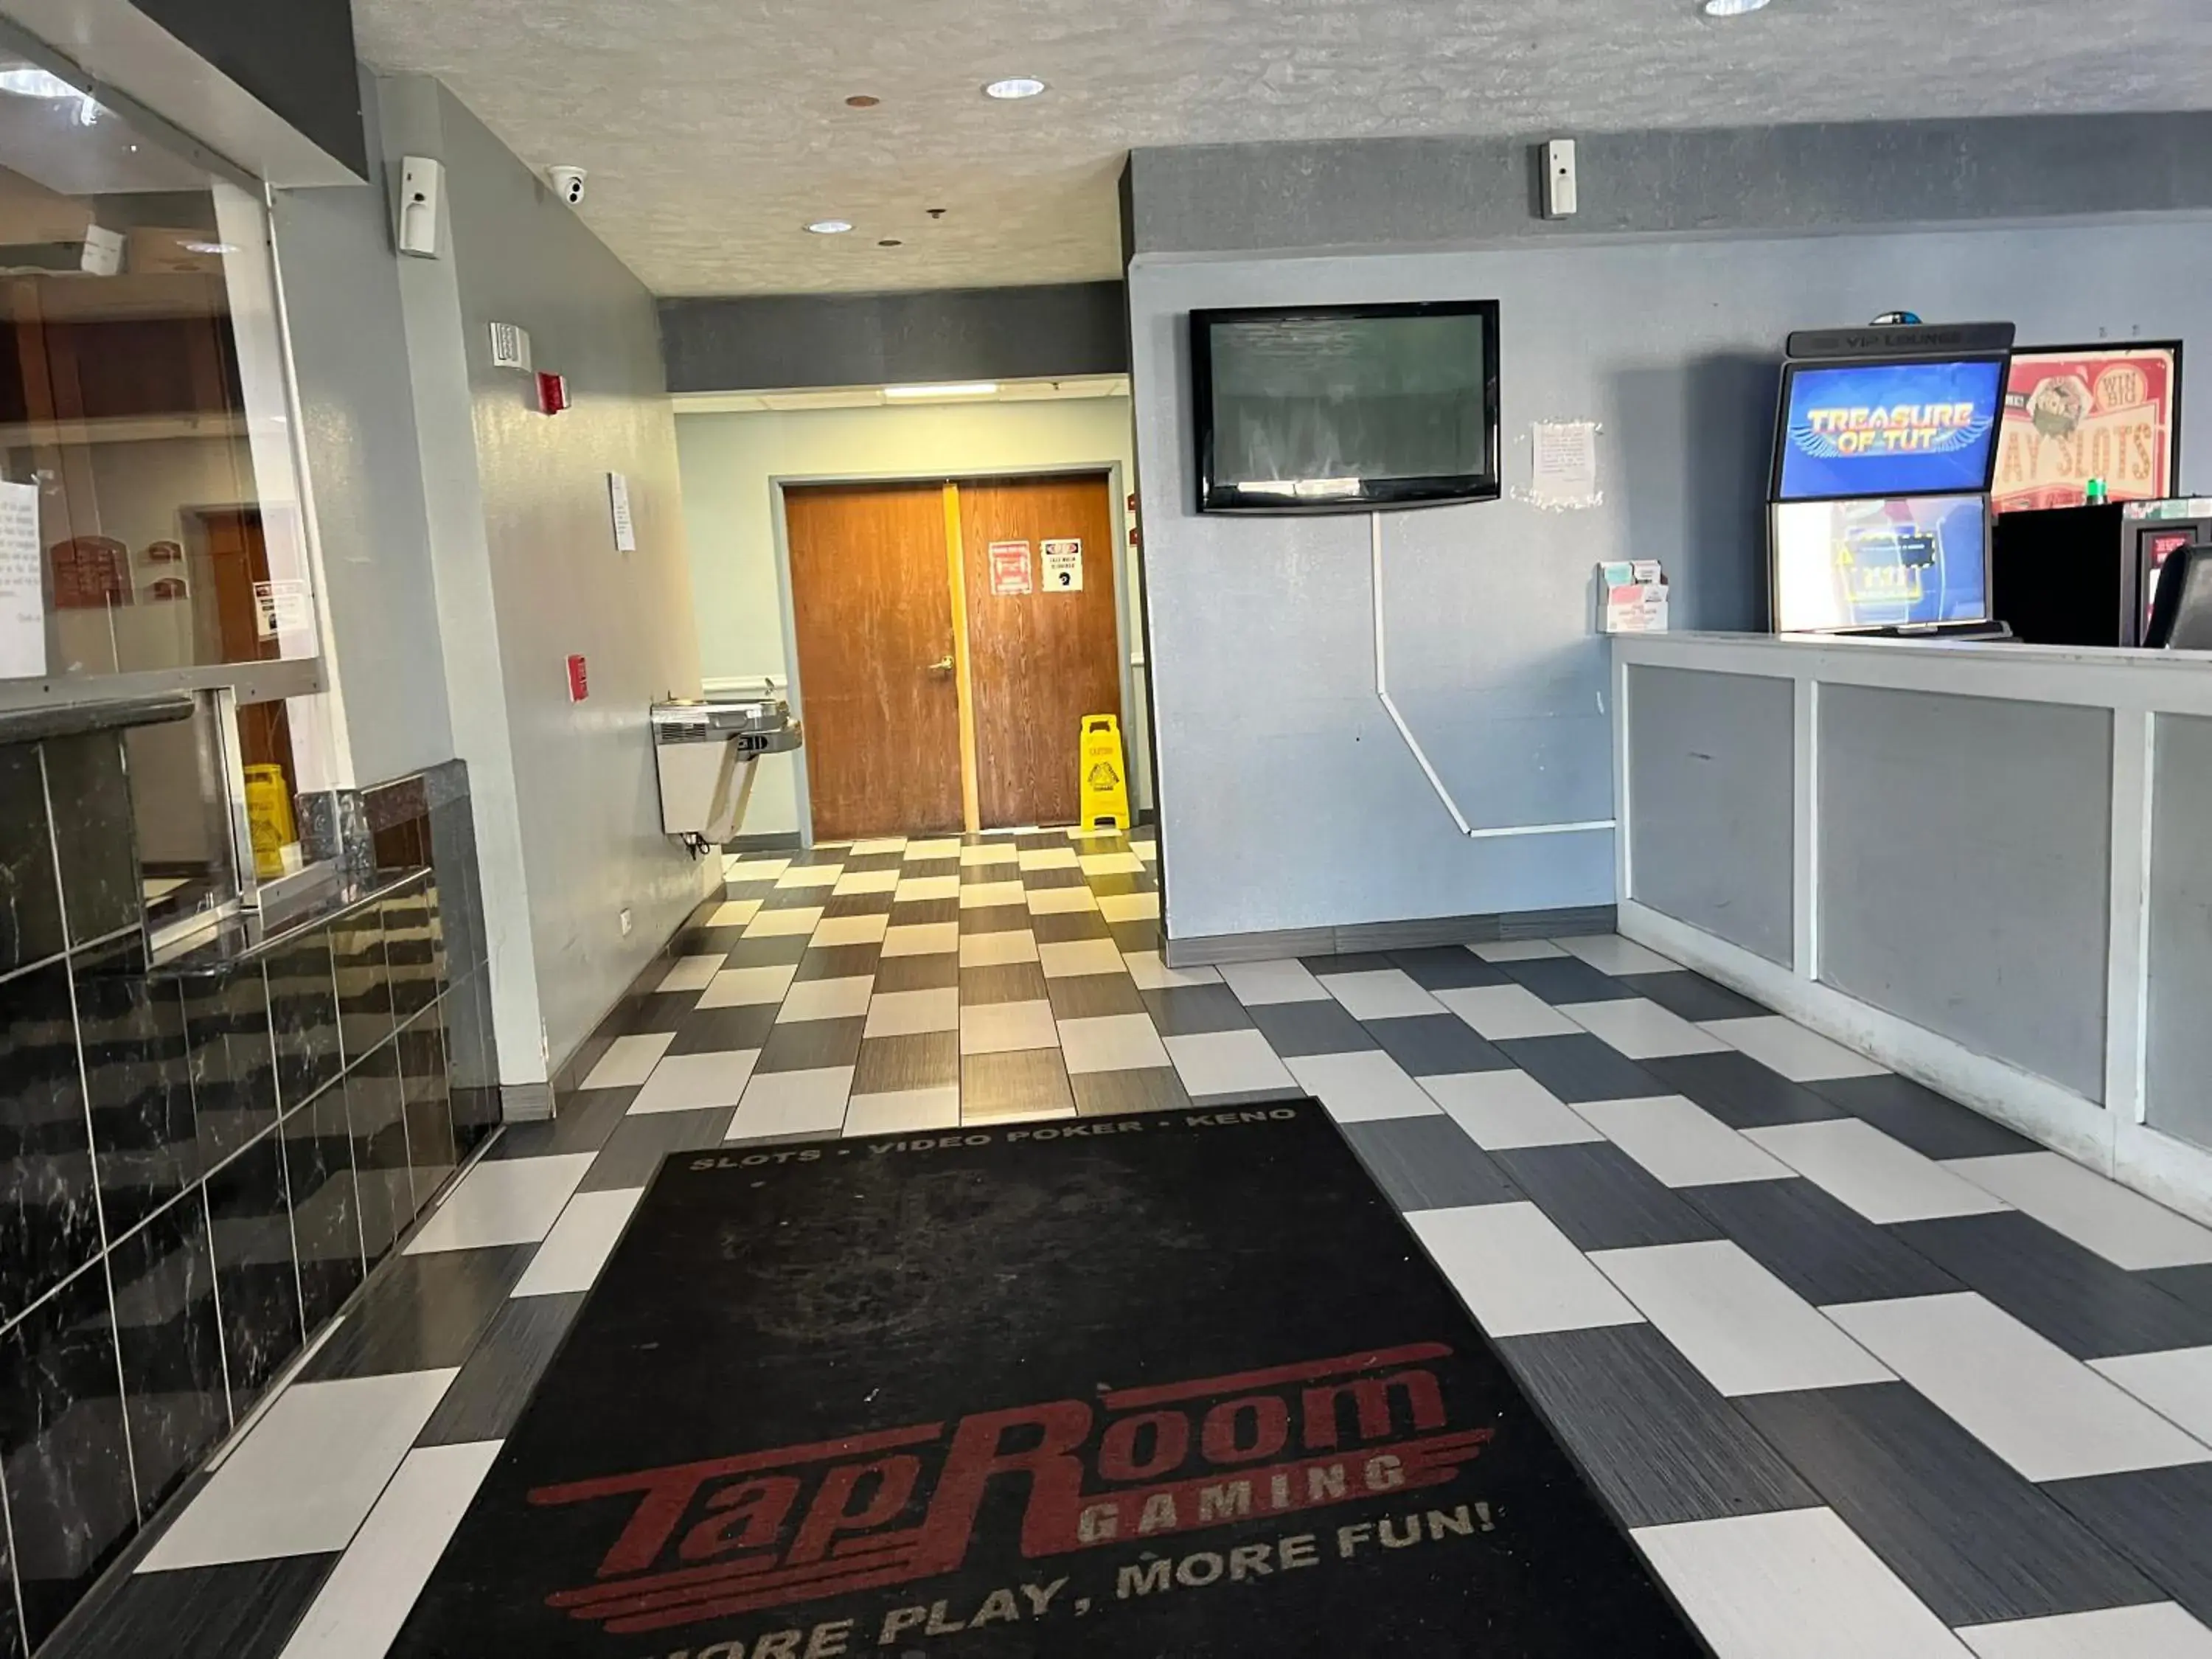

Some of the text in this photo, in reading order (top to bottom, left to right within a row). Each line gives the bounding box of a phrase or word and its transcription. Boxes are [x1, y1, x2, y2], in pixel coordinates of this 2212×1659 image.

[2103, 372, 2136, 392] WIN
[2108, 390, 2136, 406] BIG
[1808, 403, 1975, 434] TREASURE
[1837, 427, 1937, 453] OF TUT
[2056, 422, 2152, 480] SLOTS
[689, 1107, 1298, 1171] SLOTS VIDEO POKER KENO
[1077, 1454, 1405, 1545] GAMING
[640, 1501, 1496, 1659] ORE PLAY, MORE FUN!
